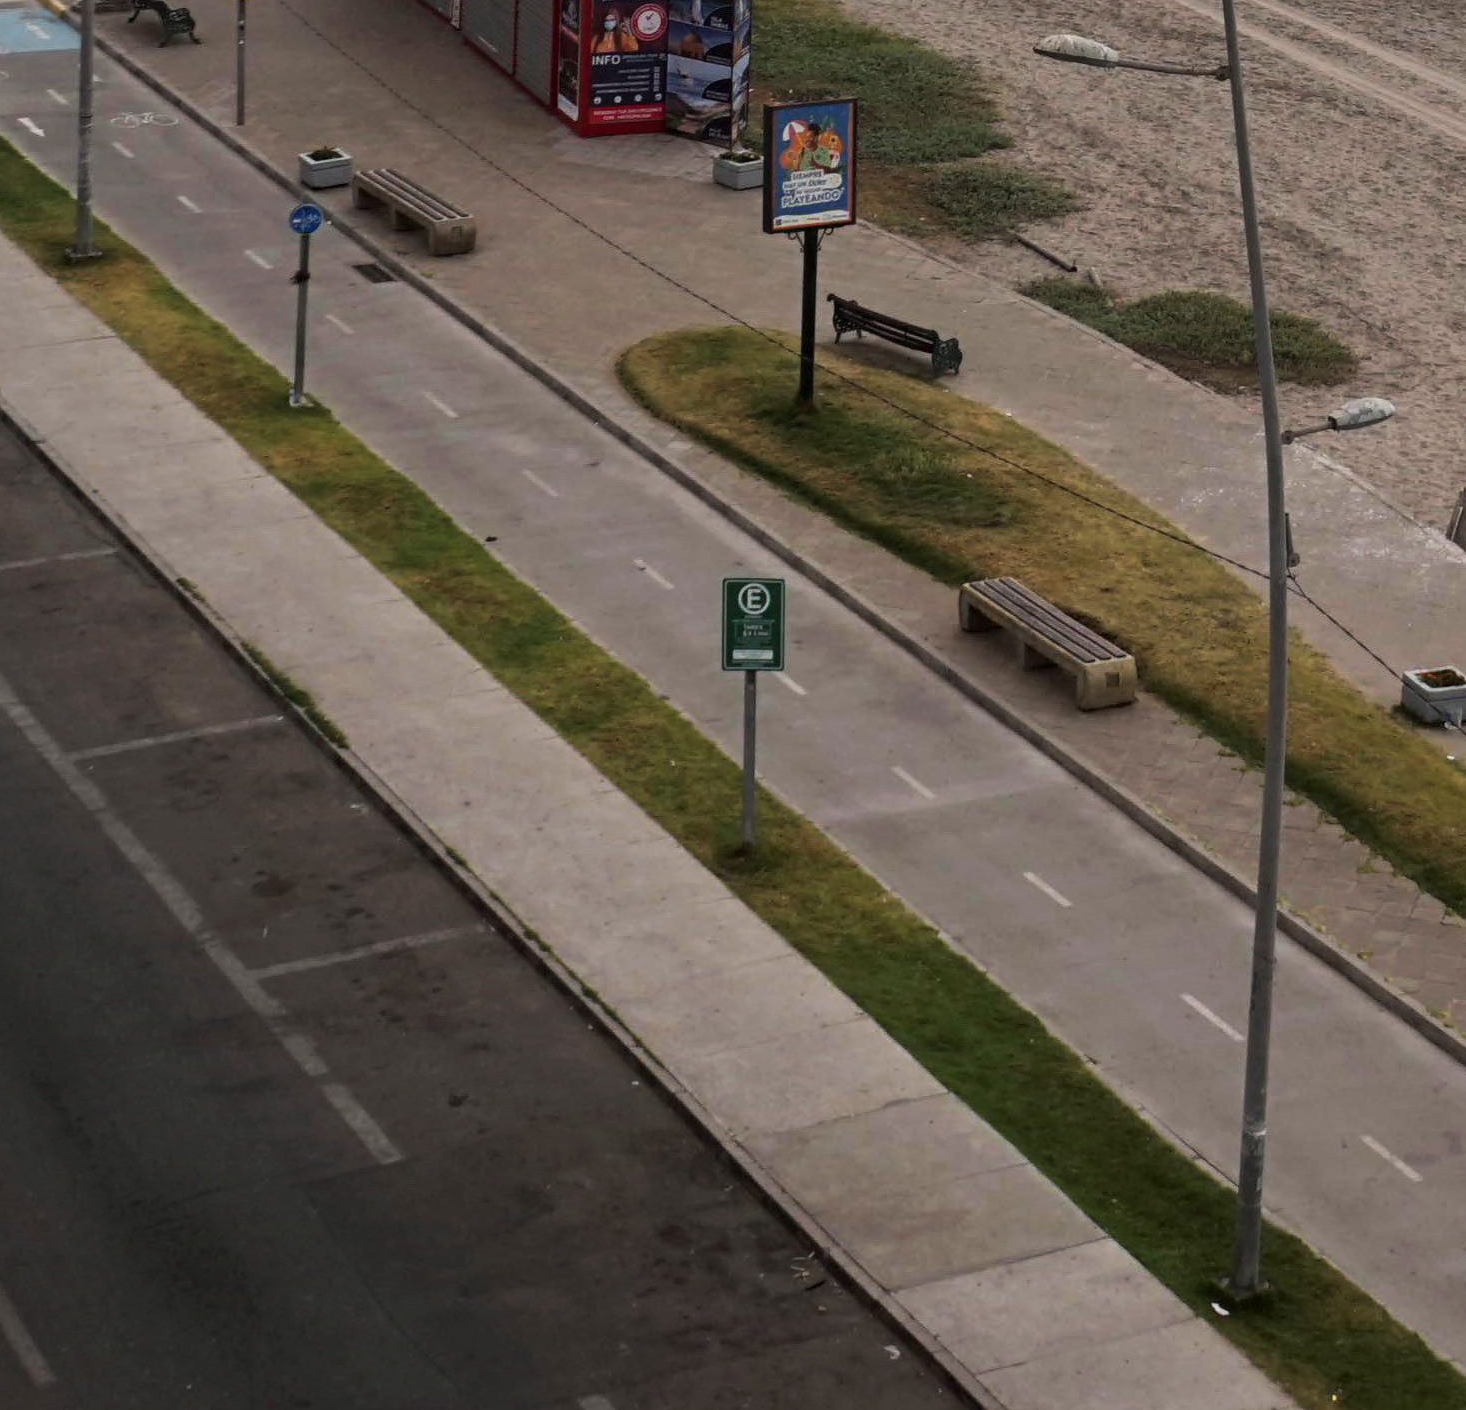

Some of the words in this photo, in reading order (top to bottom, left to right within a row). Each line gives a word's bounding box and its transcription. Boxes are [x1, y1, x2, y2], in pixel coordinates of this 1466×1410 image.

[592, 54, 621, 65] INFO
[792, 170, 822, 181] SIEMPRE
[783, 190, 840, 207] PLAYEANDO
[746, 588, 762, 609] E
